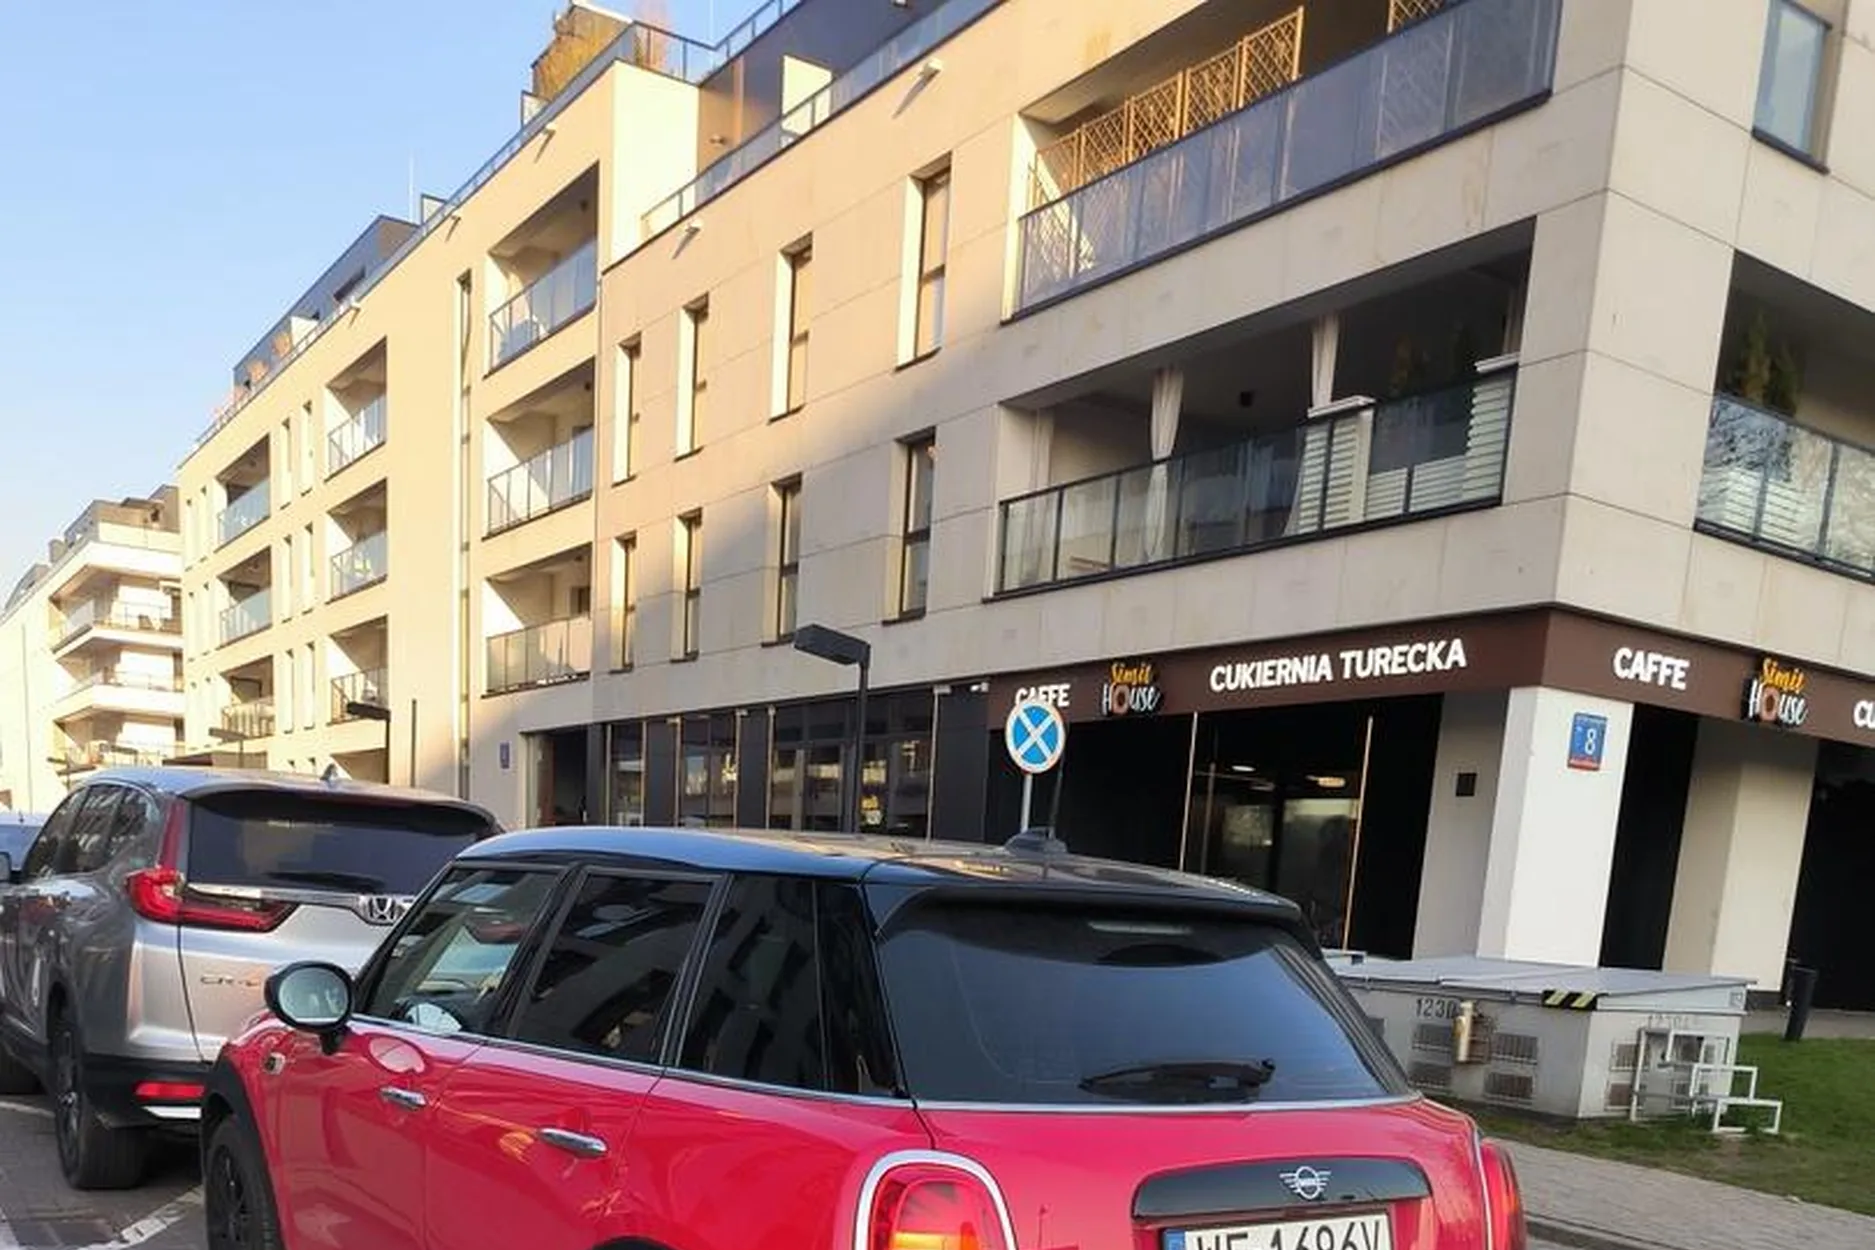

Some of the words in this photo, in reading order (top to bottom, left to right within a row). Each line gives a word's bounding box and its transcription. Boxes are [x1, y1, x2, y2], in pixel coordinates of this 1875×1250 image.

[1209, 653, 1334, 692] CUKIERNIA
[1339, 638, 1467, 680] TURECKA
[1613, 647, 1690, 690] CAFFE
[1584, 728, 1597, 756] 8
